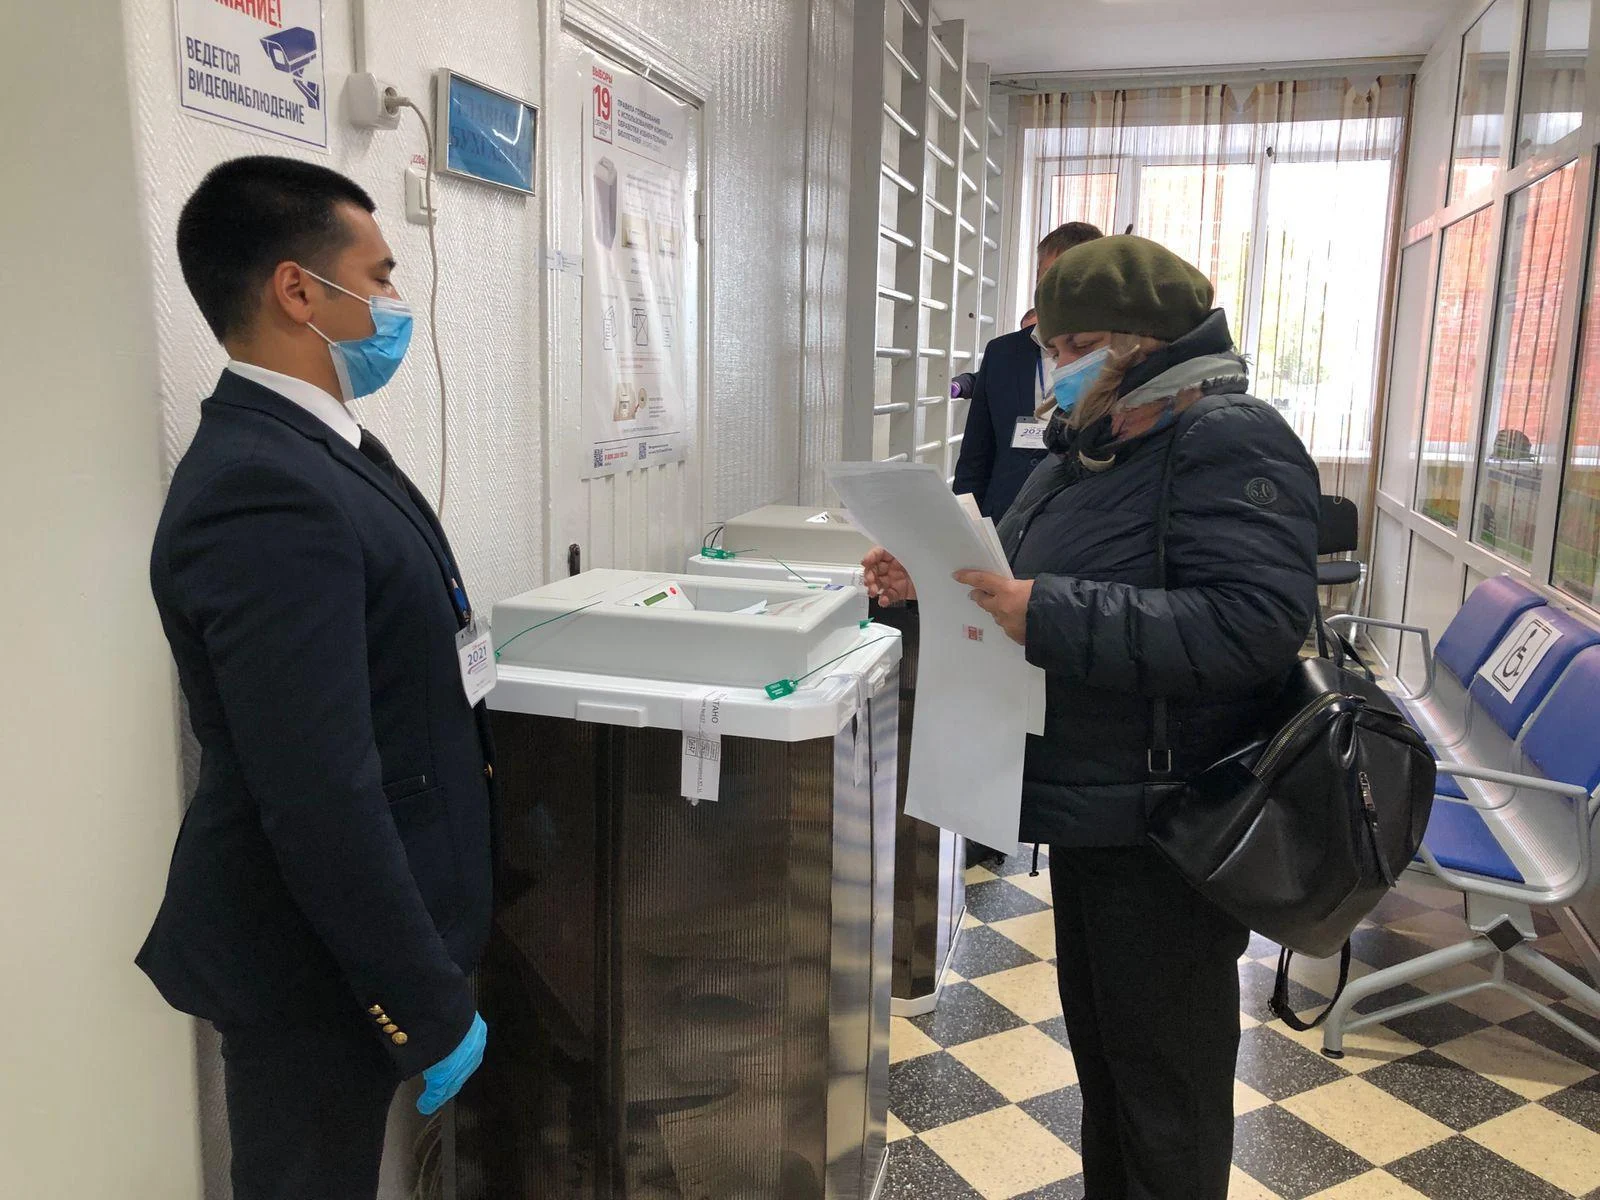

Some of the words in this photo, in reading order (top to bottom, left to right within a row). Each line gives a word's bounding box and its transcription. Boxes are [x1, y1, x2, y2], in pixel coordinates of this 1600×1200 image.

[186, 36, 241, 76] ВЕДЕТСЯ
[592, 66, 613, 84] ВЫБОРЫ
[188, 67, 305, 125] ВИДЕОНАБЛЮДЕНИЕ
[592, 85, 611, 121] 19
[467, 646, 487, 666] 2021
